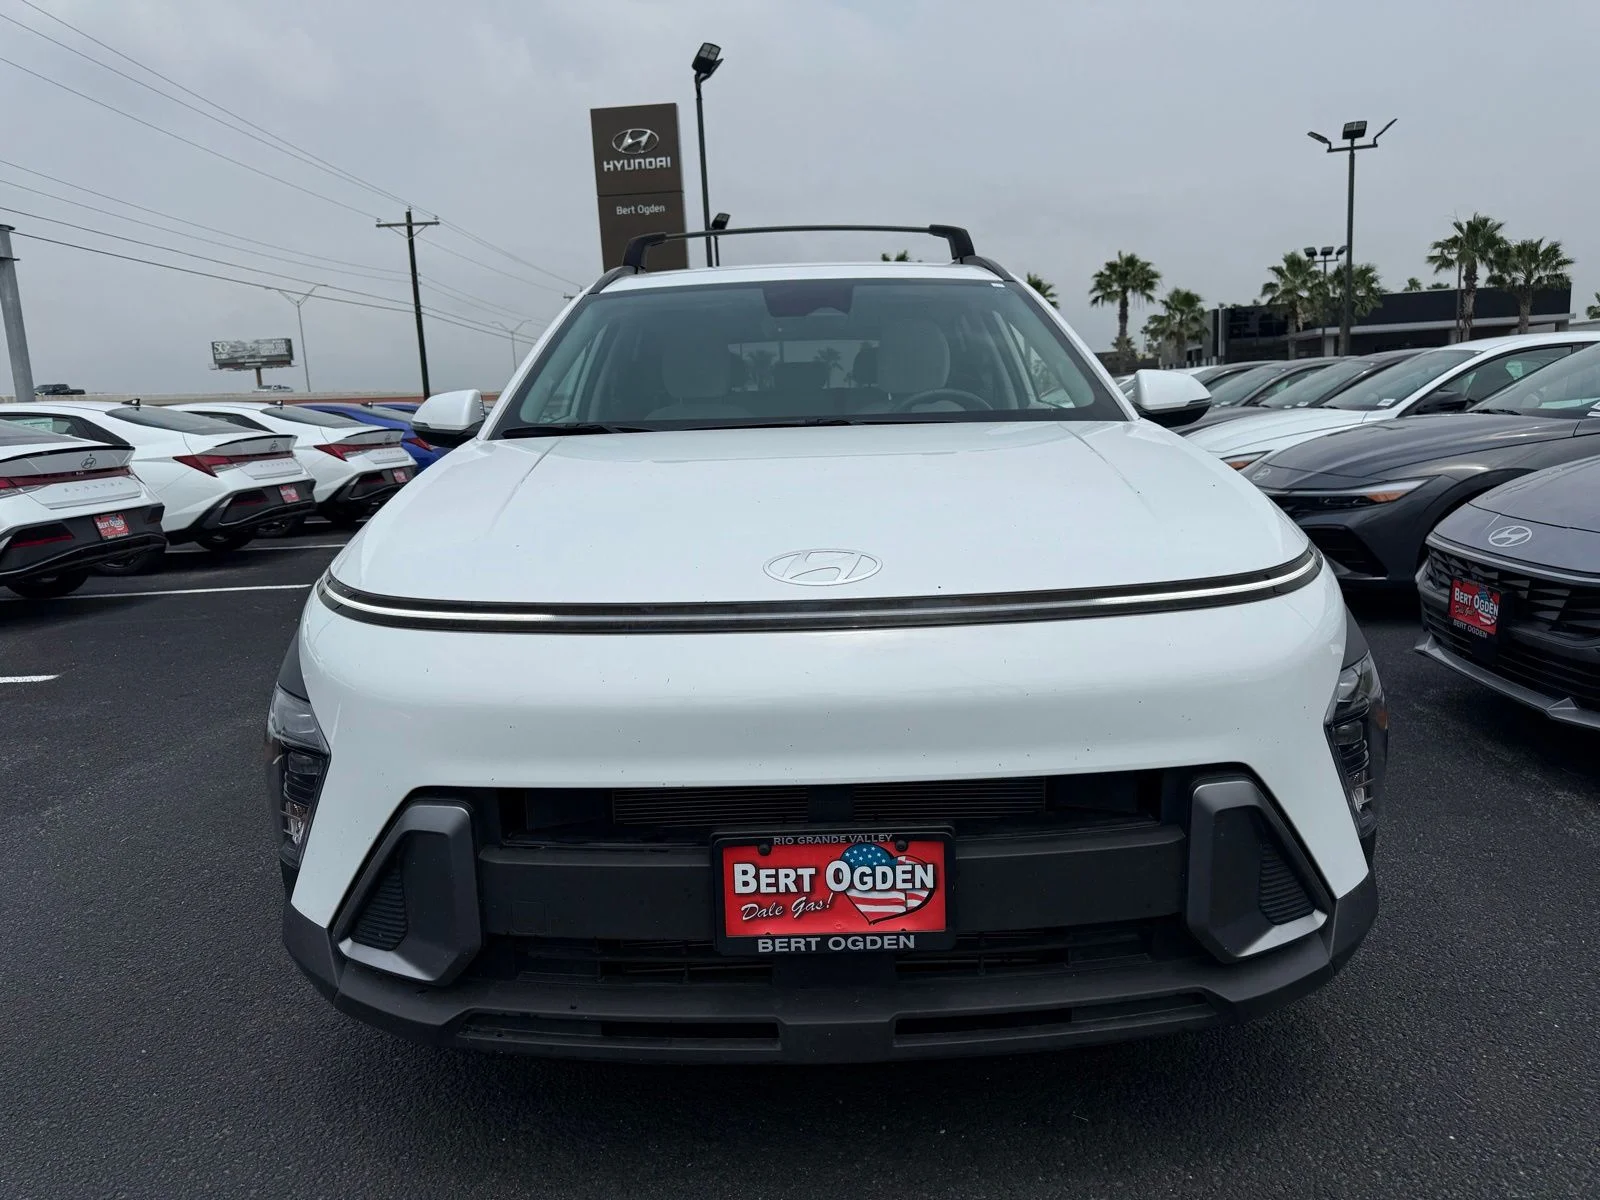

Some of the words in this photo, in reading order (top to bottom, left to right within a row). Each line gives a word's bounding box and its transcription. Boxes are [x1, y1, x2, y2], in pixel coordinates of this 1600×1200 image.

[603, 157, 671, 172] HYUNDAI
[616, 206, 635, 215] Bert
[637, 204, 665, 215] Ogden
[1454, 587, 1473, 606] BERT
[1473, 594, 1499, 617] OGDEN
[1467, 625, 1488, 638] OGDEN
[773, 836, 793, 846] RIO
[797, 835, 846, 845] GRANDE
[848, 834, 893, 844] VALLEY
[733, 862, 816, 894] BERT
[825, 860, 935, 892] OGDEN
[740, 902, 783, 921] Dale
[791, 892, 834, 919] Gas!
[757, 937, 821, 953] BERT
[828, 935, 915, 951] OGDEN
